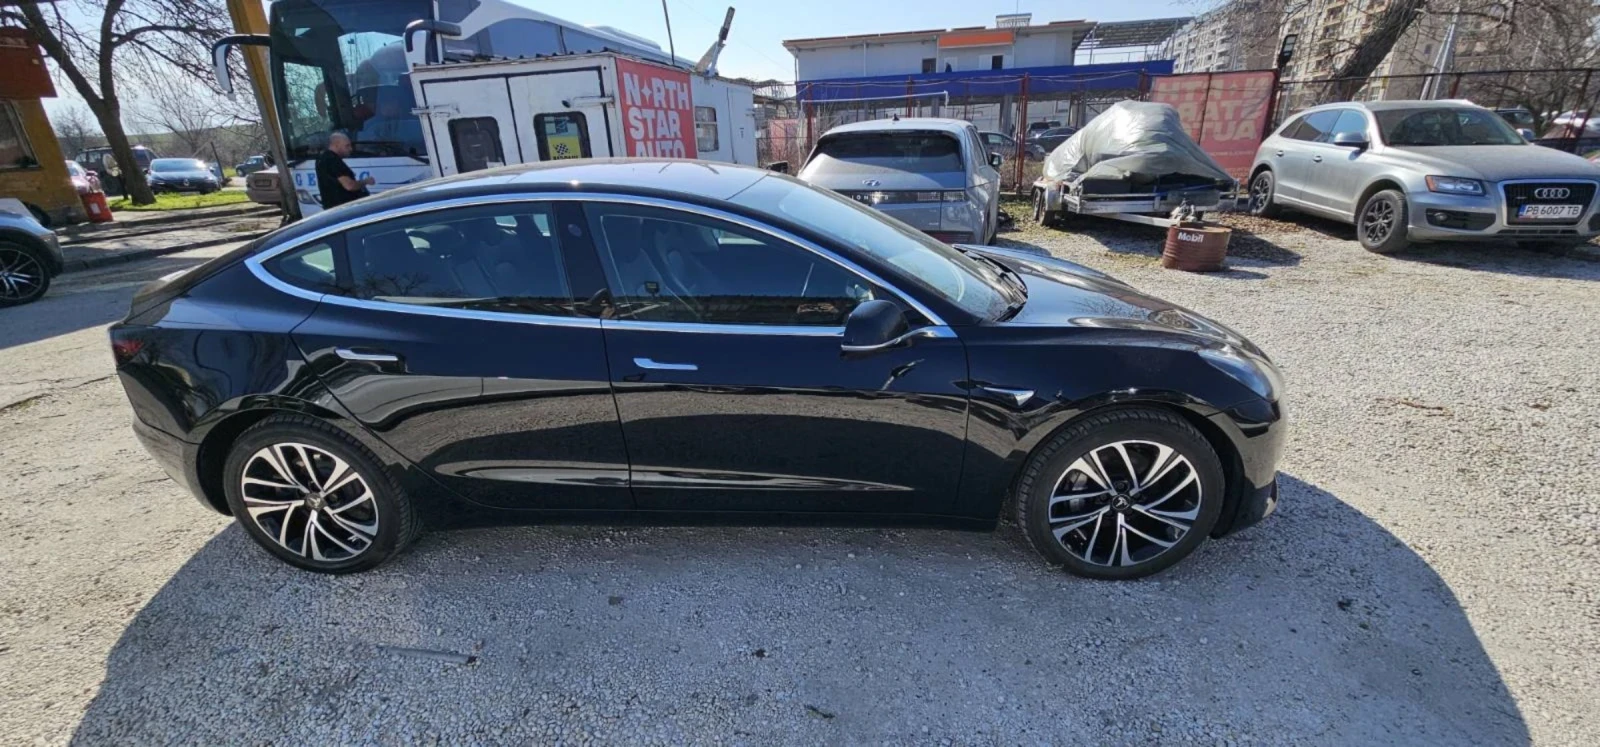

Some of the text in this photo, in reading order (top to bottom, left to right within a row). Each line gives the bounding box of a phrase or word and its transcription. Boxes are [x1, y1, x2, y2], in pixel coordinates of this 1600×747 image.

[628, 106, 682, 140] STAR
[1526, 206, 1580, 215] PB 6007 TB
[1178, 231, 1204, 243] Mobil
